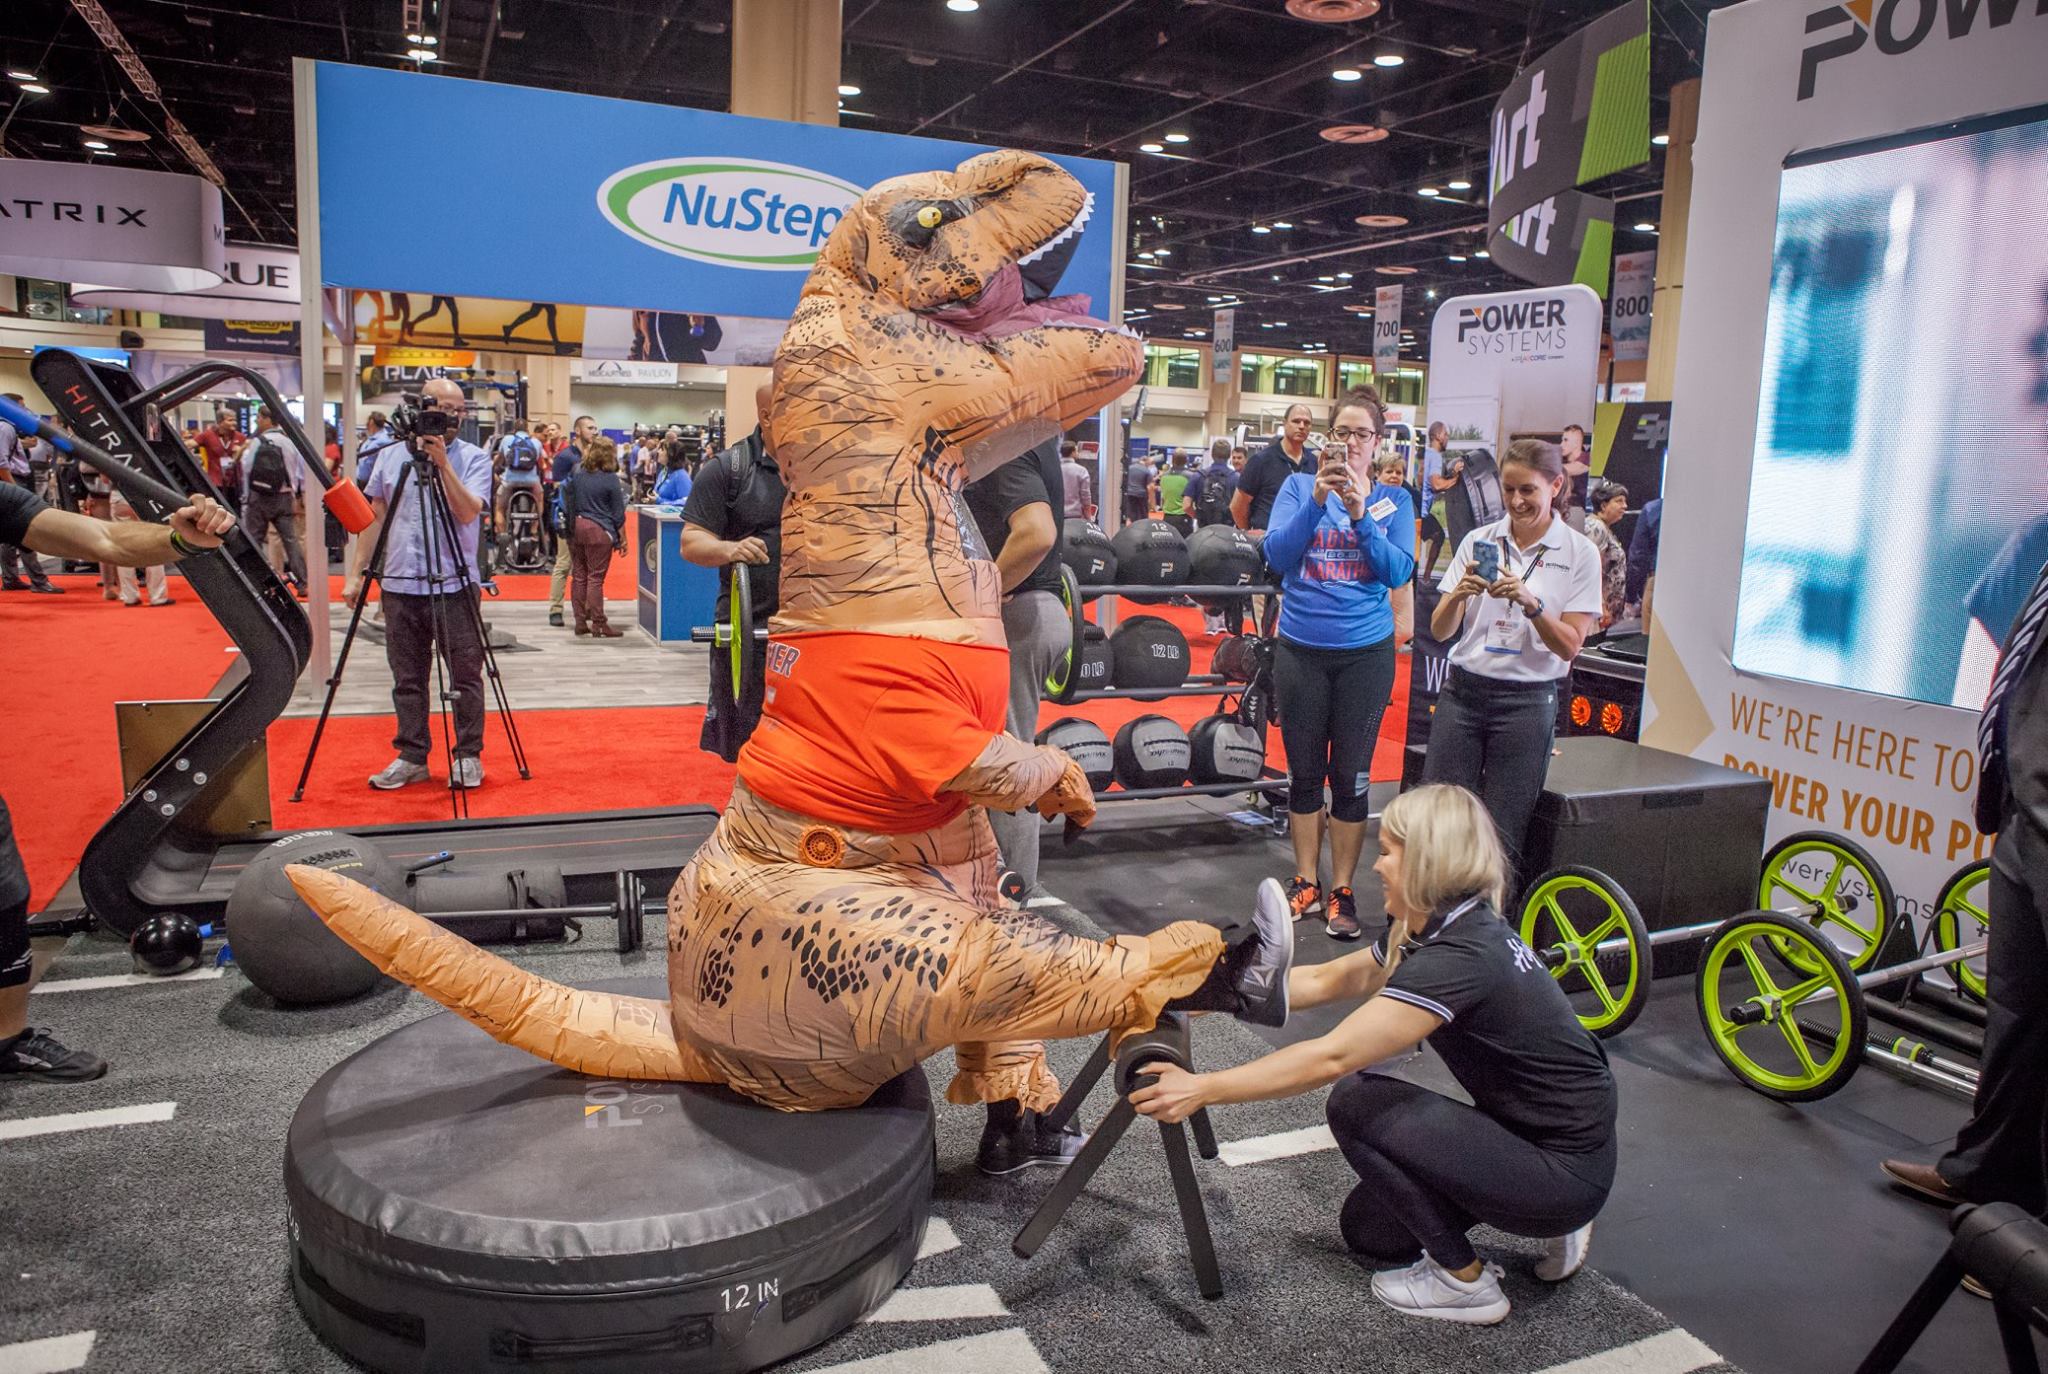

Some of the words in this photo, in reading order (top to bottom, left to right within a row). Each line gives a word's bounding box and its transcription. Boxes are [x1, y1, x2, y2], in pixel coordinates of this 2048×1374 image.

[1797, 0, 2048, 102] POW
[662, 182, 843, 247] NuStep
[1458, 298, 1567, 343] POWER
[1615, 295, 1650, 319] 800
[1214, 338, 1232, 353] 600
[1375, 320, 1399, 339] 700
[1467, 327, 1567, 356] SYSTEMS
[1152, 522, 1168, 531] 12
[1151, 643, 1166, 658] 12
[1425, 655, 1450, 693] W
[1731, 692, 1823, 755] WE'RE
[1832, 720, 1920, 781] HERE
[1934, 743, 1975, 793] TO
[1841, 788, 1935, 855] YOUR
[720, 1283, 751, 1313] 12
[758, 1277, 779, 1303] IN
